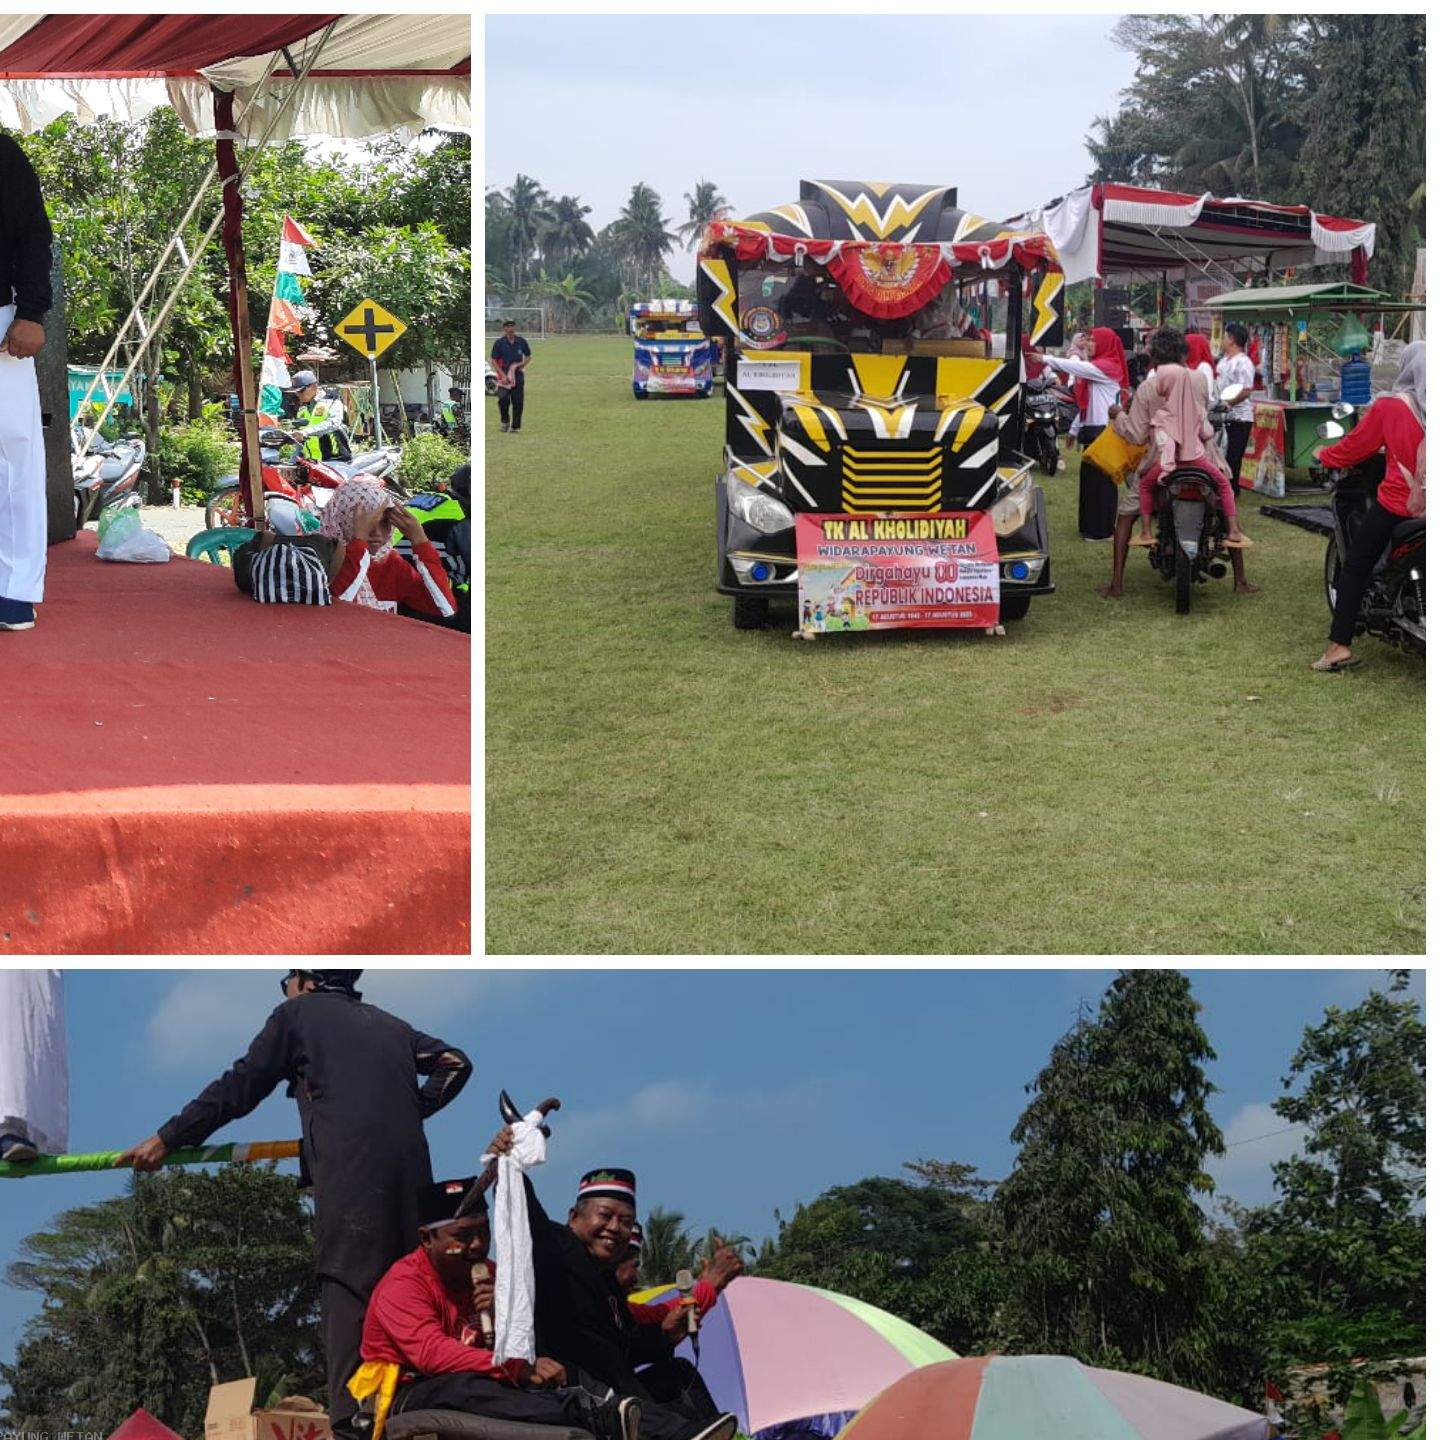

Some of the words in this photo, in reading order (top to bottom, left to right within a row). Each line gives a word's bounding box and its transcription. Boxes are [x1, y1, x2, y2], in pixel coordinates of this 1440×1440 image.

[823, 520, 846, 541] TK
[848, 520, 870, 540] AL
[873, 518, 968, 540] KHOLIDIYAH
[817, 544, 924, 557] WIDARAPAYUNG
[928, 543, 977, 556] WETAN
[855, 561, 931, 588] Dirgahayu
[854, 587, 918, 606] REPUBLIK
[921, 585, 994, 604] INDONESIA
